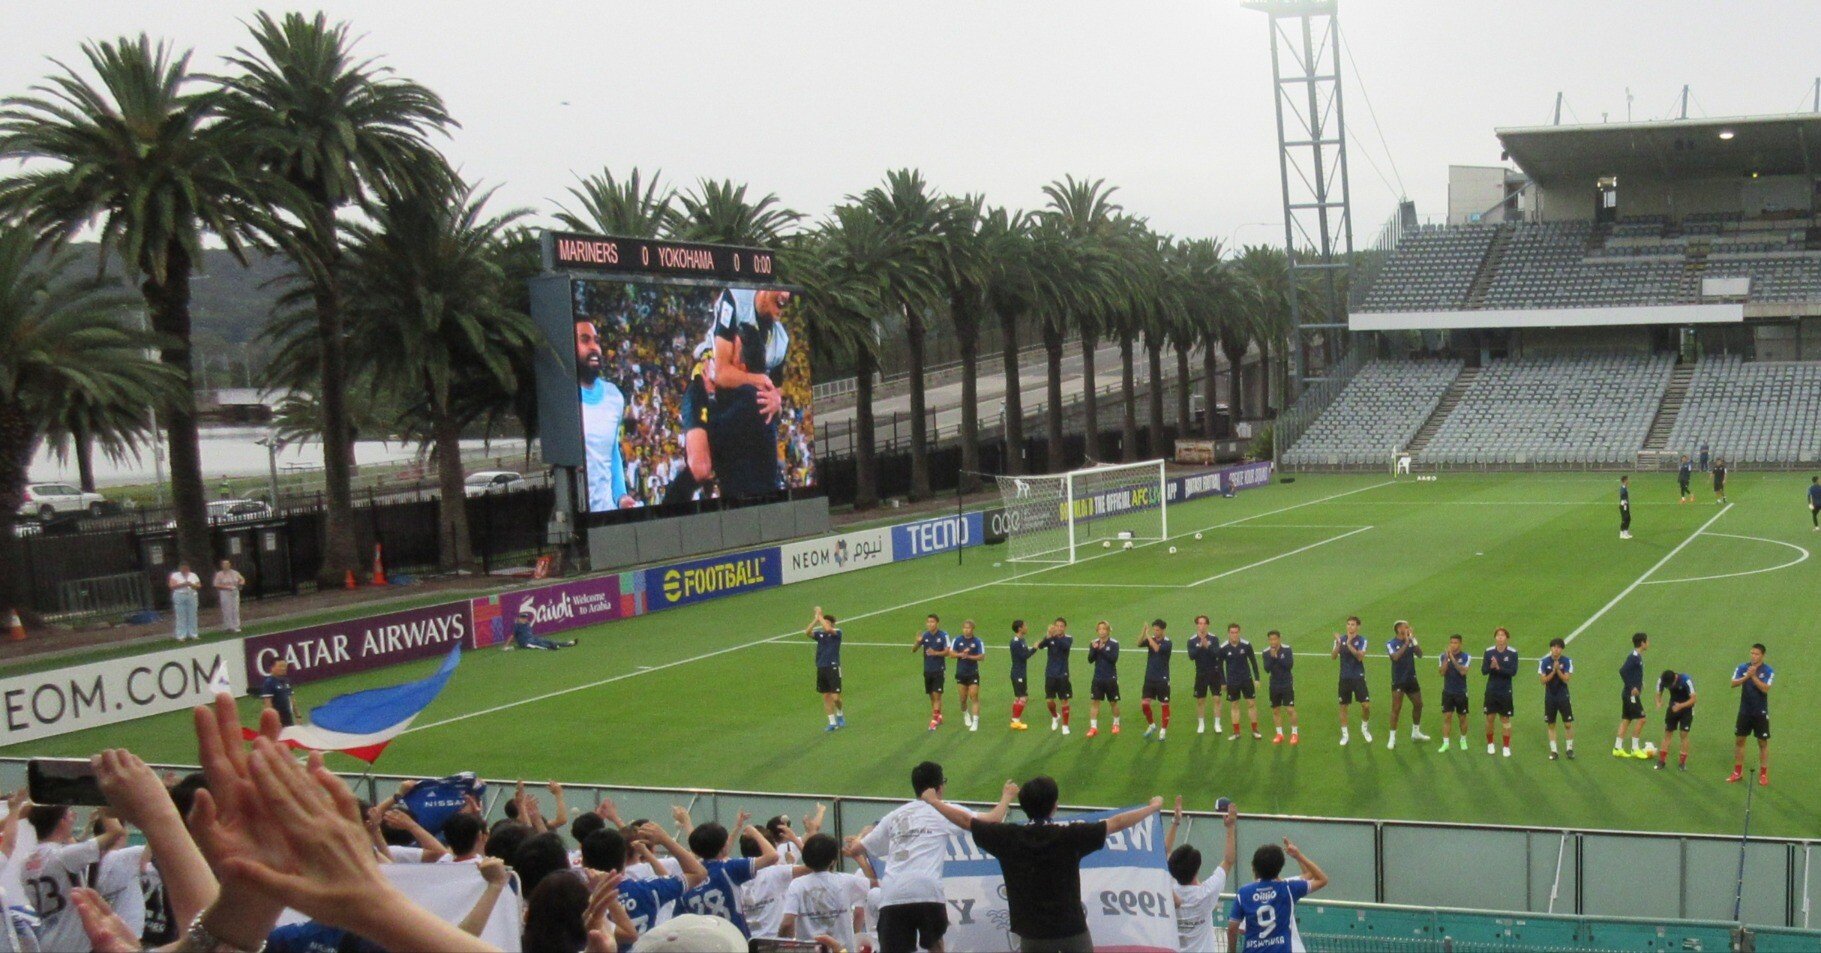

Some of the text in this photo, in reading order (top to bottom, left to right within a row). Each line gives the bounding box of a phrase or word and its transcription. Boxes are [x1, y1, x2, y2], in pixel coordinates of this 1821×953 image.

[559, 240, 771, 274] MARINERS 0 YOKOHAMA 0 0:00
[1132, 488, 1148, 506] AFC
[907, 517, 969, 554] TECNO
[793, 549, 830, 570] NEOM
[519, 591, 574, 627] Saudi
[573, 593, 606, 606] Welcome
[579, 600, 611, 615] to Arabia
[362, 613, 465, 657] AIRWAYS
[1256, 904, 1277, 939] 9
